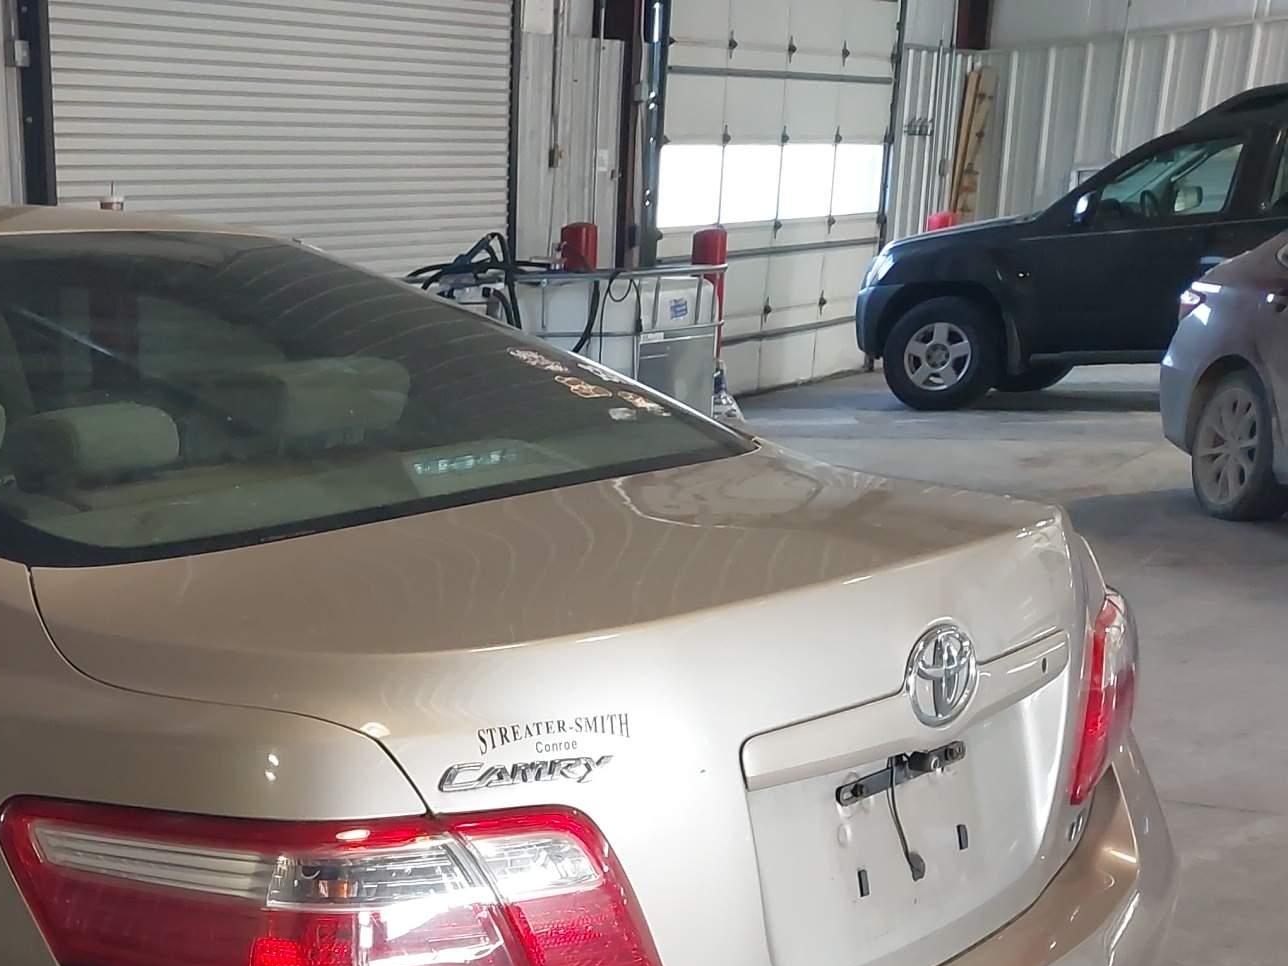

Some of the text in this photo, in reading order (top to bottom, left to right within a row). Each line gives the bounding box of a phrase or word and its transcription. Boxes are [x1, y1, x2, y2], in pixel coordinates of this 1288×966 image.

[477, 712, 631, 756] STREATER-SMITH
[535, 738, 579, 754] Conroe
[437, 754, 614, 793] CAMRY
